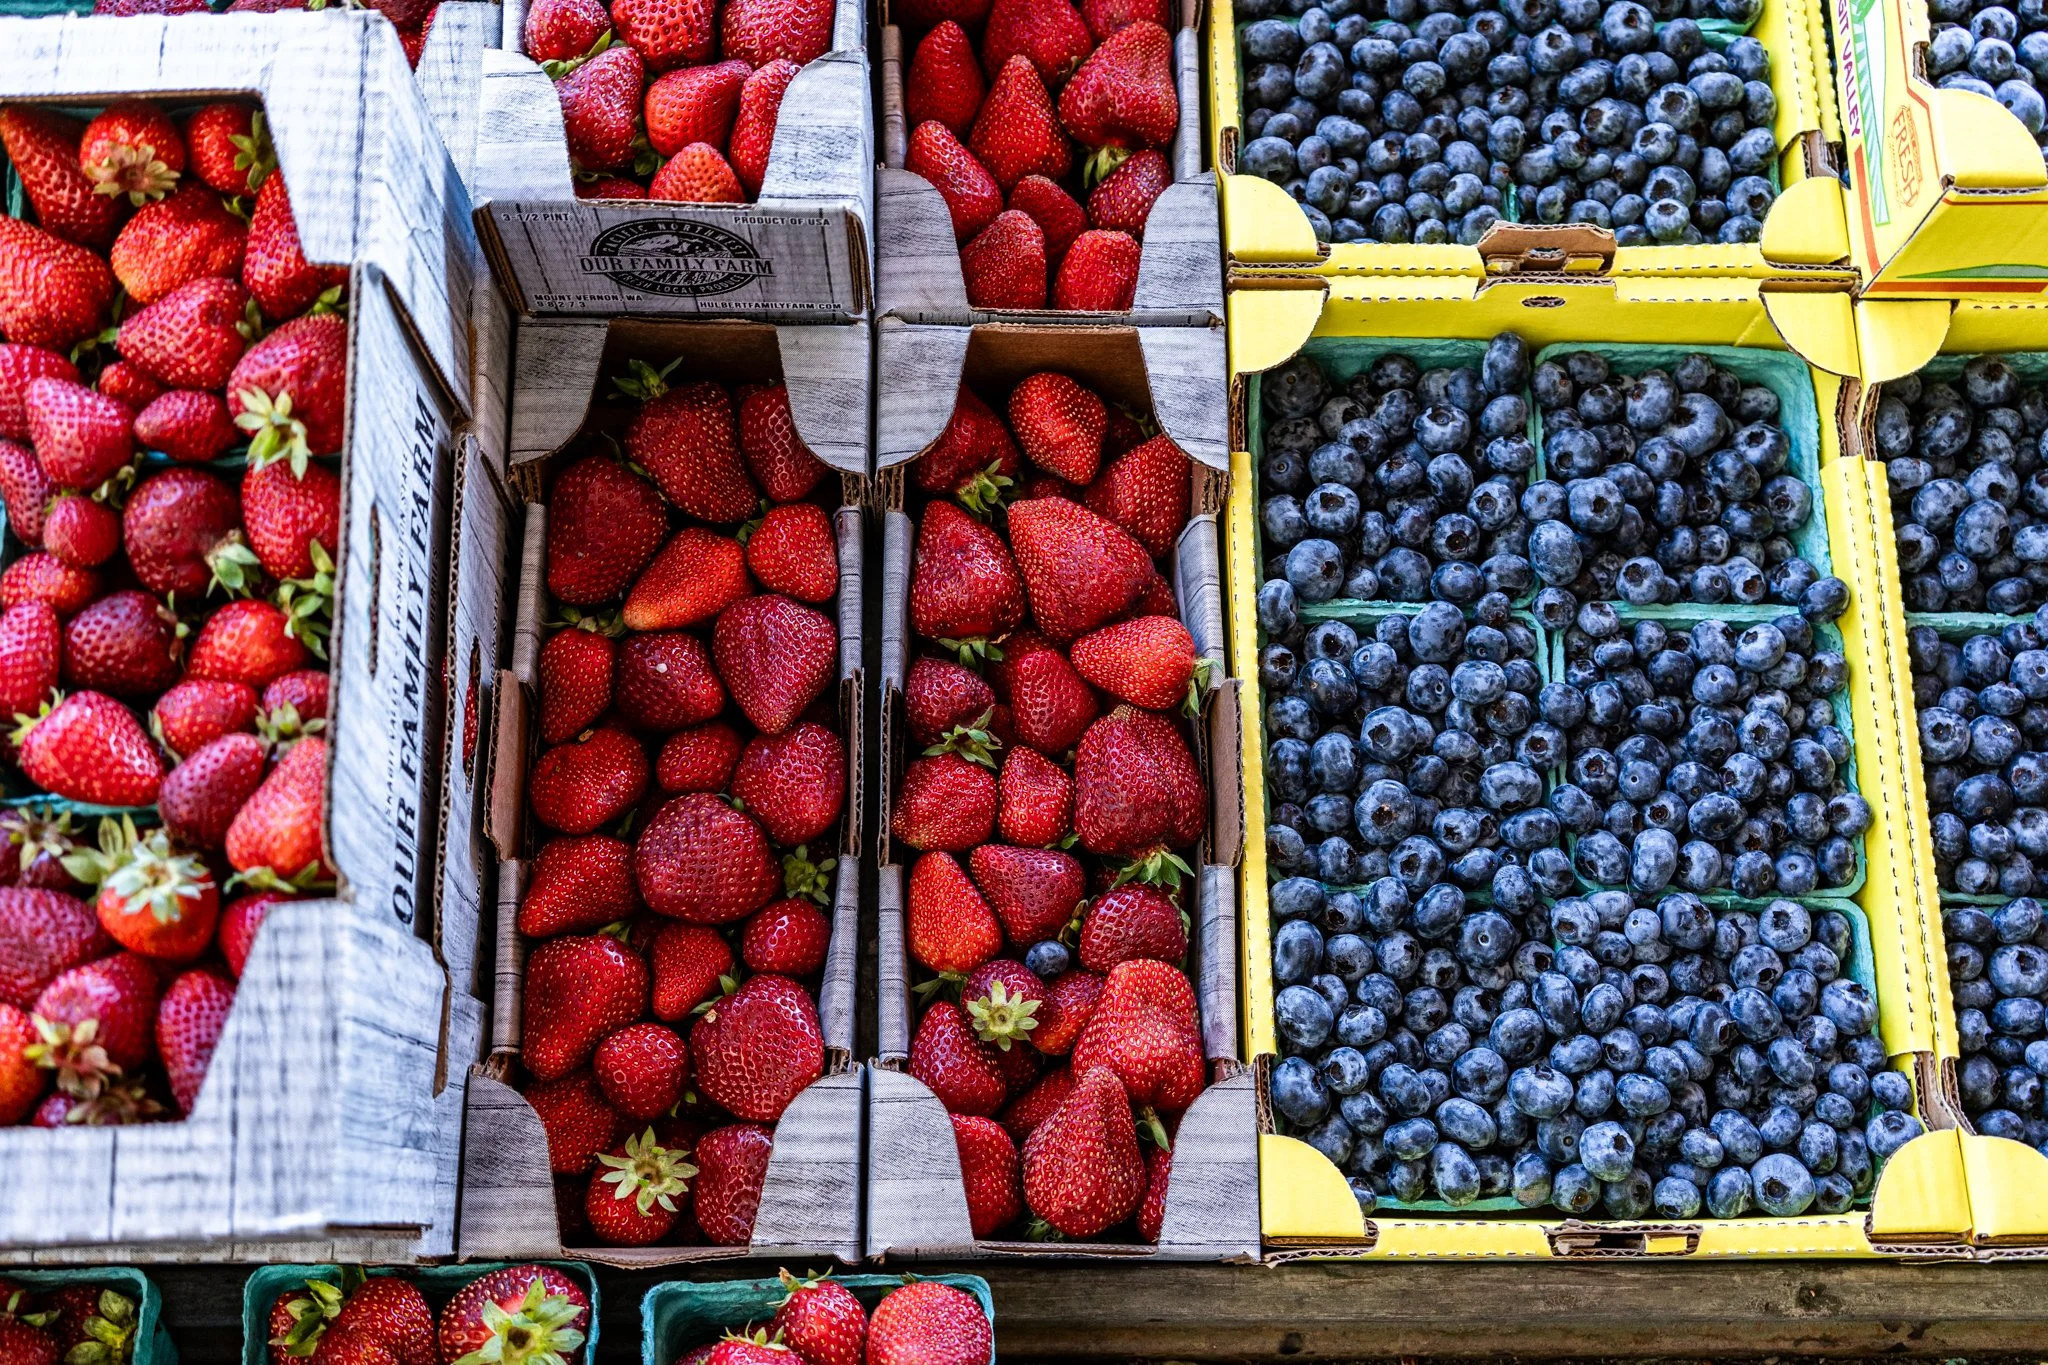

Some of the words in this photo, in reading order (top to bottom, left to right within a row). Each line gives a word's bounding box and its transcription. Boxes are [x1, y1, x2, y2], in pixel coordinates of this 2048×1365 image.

[1838, 0, 1849, 34] GIT
[1843, 38, 1860, 136] VALLEY
[1893, 109, 1919, 207] FRESH
[543, 213, 569, 221] PINT
[734, 216, 785, 225] PRODUCT
[790, 217, 804, 225] OF
[808, 217, 830, 225] USA
[602, 223, 648, 253] PACIFIC
[657, 222, 747, 256] NORTHWEST
[580, 257, 623, 272] OUR
[629, 257, 705, 271] FAMILY
[715, 259, 774, 275] FARM
[655, 285, 695, 294] LOCAL
[700, 273, 745, 293] PRODUCE
[410, 387, 436, 558] FARM
[400, 556, 423, 784] FAMILY
[392, 797, 416, 926] OUR
